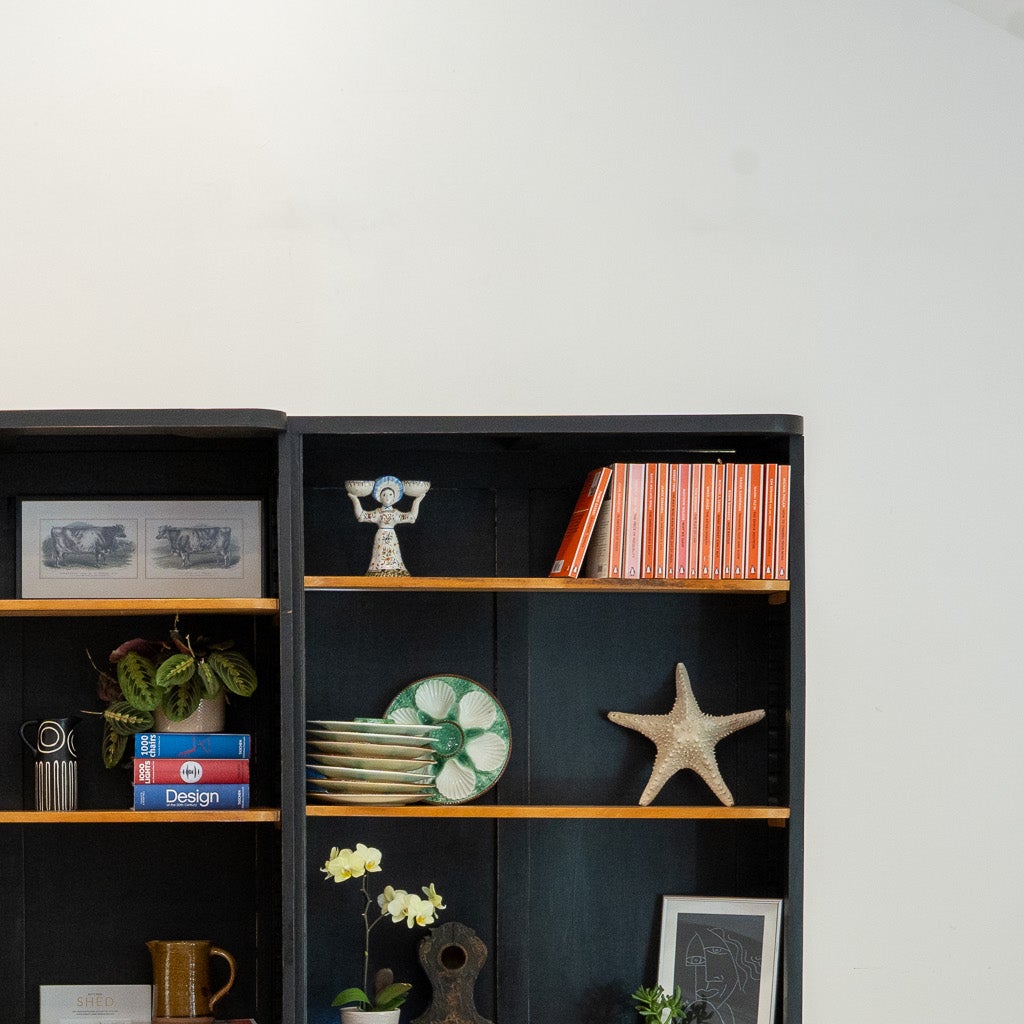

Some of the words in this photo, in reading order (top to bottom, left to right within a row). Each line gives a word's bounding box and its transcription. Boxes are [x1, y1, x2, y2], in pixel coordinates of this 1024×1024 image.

[141, 735, 149, 756] 1000
[166, 789, 219, 807] Design
[77, 997, 114, 1007] SHED
